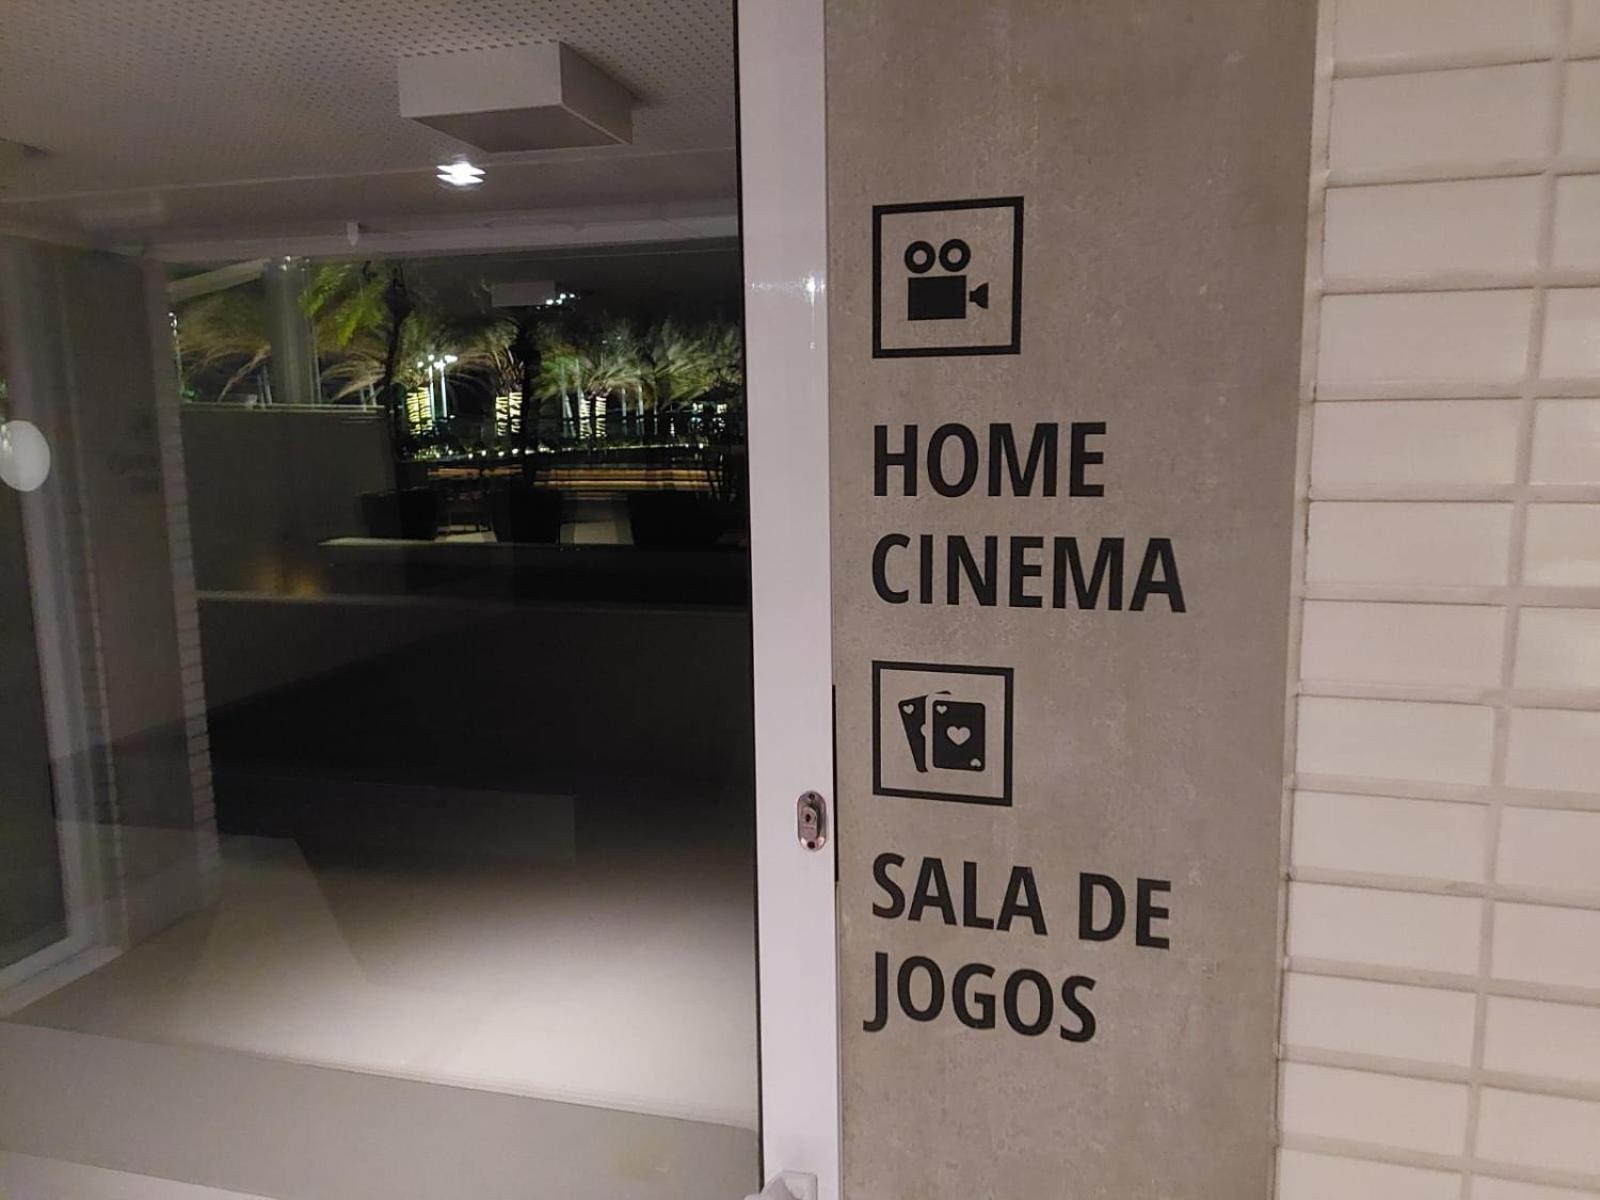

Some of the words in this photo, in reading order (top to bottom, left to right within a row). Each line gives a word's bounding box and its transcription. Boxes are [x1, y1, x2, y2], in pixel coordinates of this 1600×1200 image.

[874, 421, 1107, 499] HOME
[872, 533, 1187, 613] CINEMA
[873, 853, 1049, 936] SALA
[1079, 872, 1172, 950] DE
[863, 952, 1097, 1043] JOGOS
